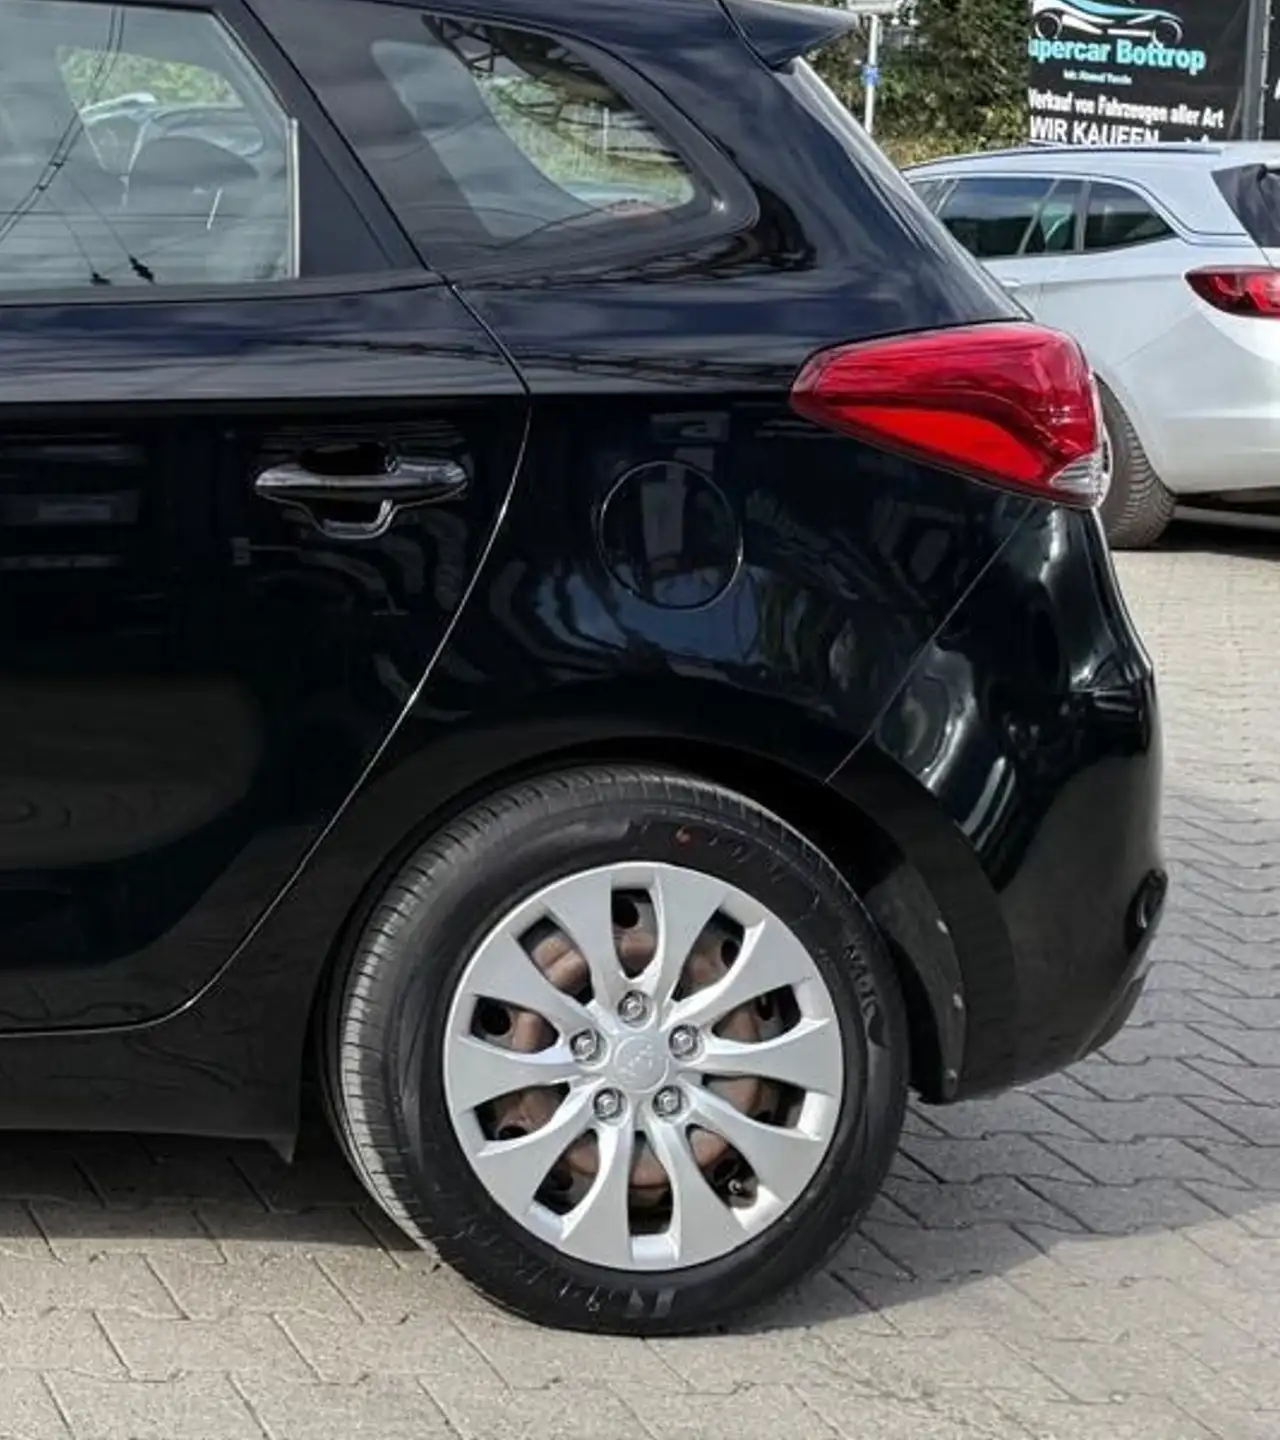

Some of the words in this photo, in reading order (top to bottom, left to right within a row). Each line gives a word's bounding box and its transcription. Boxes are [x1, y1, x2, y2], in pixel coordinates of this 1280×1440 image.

[1027, 35, 1111, 63] upercar
[1116, 38, 1206, 75] Bottrop
[1097, 93, 1168, 125] Fahrzeugen
[1170, 103, 1201, 126] aller
[1202, 106, 1224, 129] Art
[1029, 115, 1068, 143] WIR
[1072, 119, 1159, 145] KAUFEN
